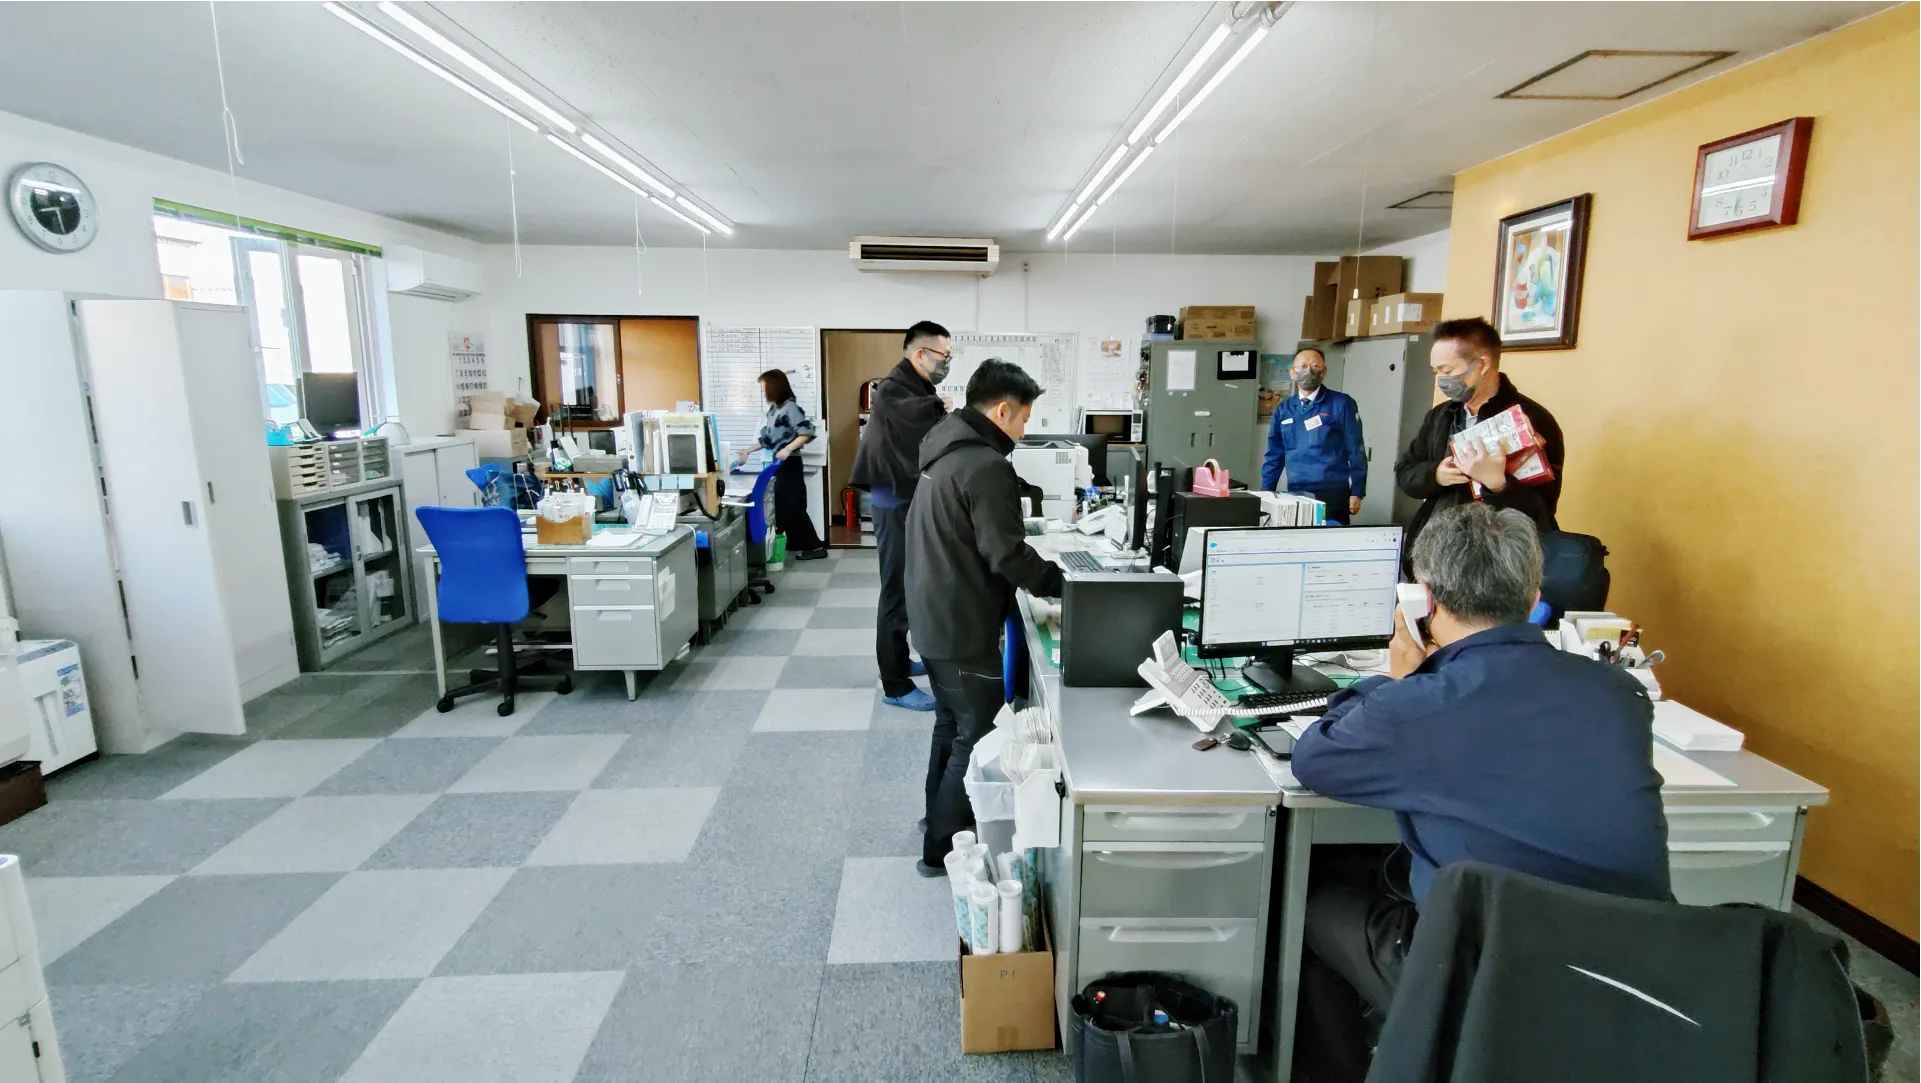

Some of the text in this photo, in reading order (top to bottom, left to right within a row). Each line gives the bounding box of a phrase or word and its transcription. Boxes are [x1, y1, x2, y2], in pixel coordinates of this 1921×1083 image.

[1742, 149, 1753, 160] 12
[1729, 155, 1738, 167] 11
[1764, 156, 1773, 168] 2
[1718, 169, 1729, 180] 10
[1715, 197, 1723, 207] 8
[1748, 199, 1758, 212] 5
[1724, 205, 1732, 216] 7
